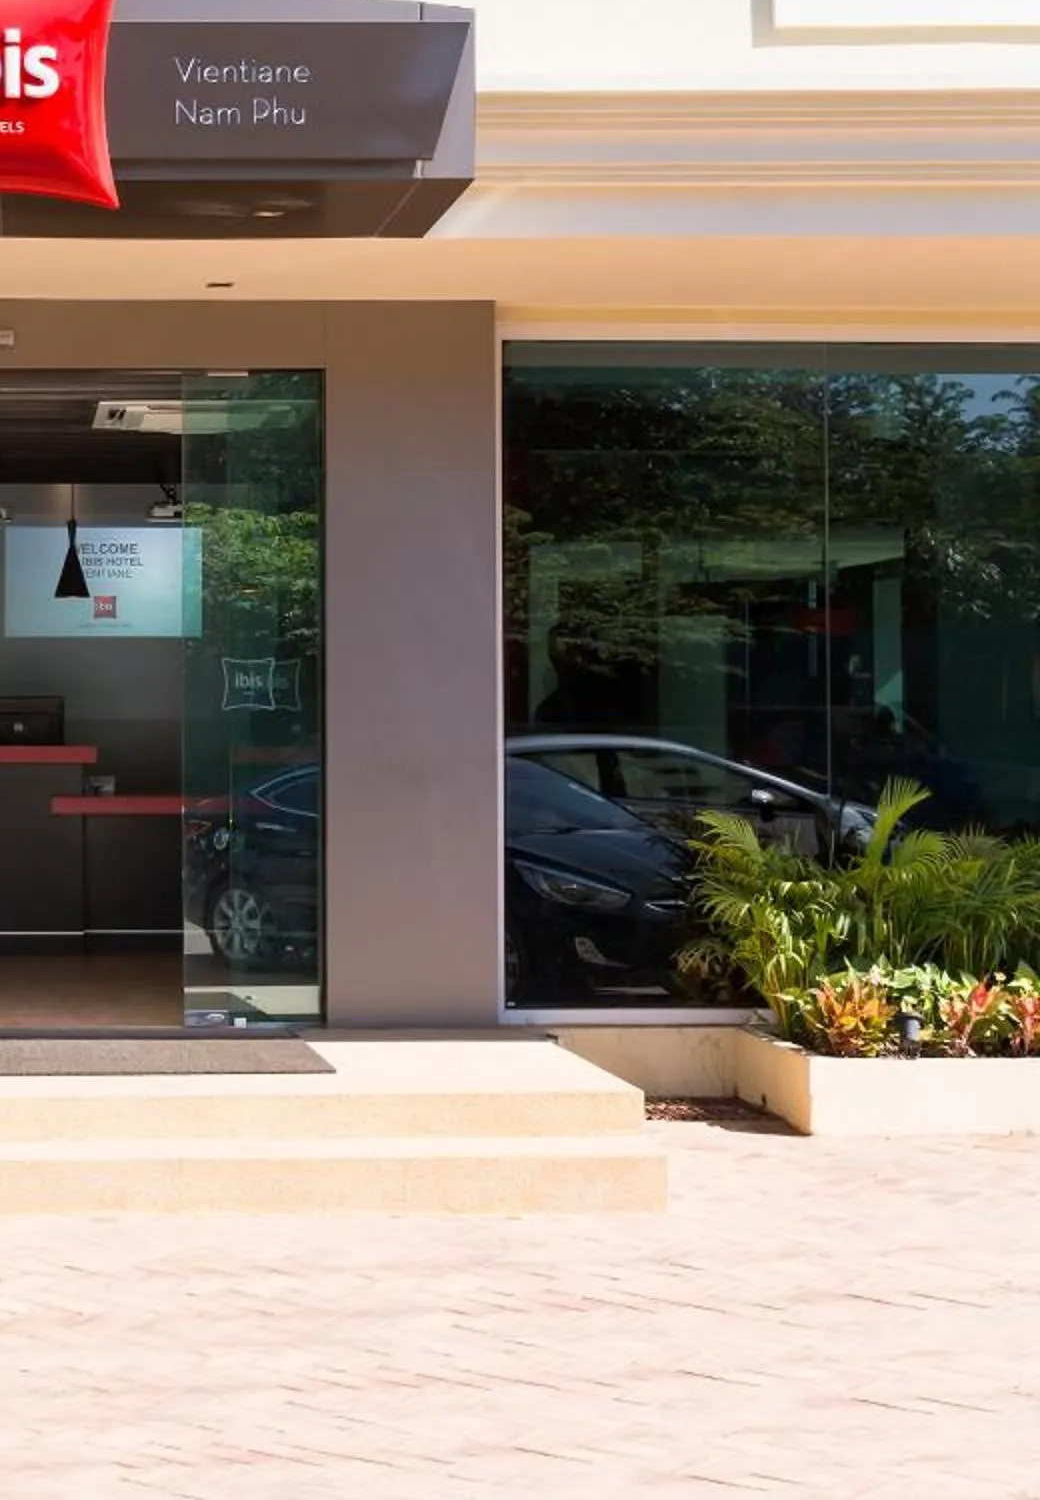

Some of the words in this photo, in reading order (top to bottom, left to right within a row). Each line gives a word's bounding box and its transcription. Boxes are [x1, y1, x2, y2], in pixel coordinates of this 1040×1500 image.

[175, 57, 311, 83] Vientiane
[175, 98, 241, 125] Nam
[253, 96, 305, 125] Phu
[105, 557, 144, 566] HOTEL
